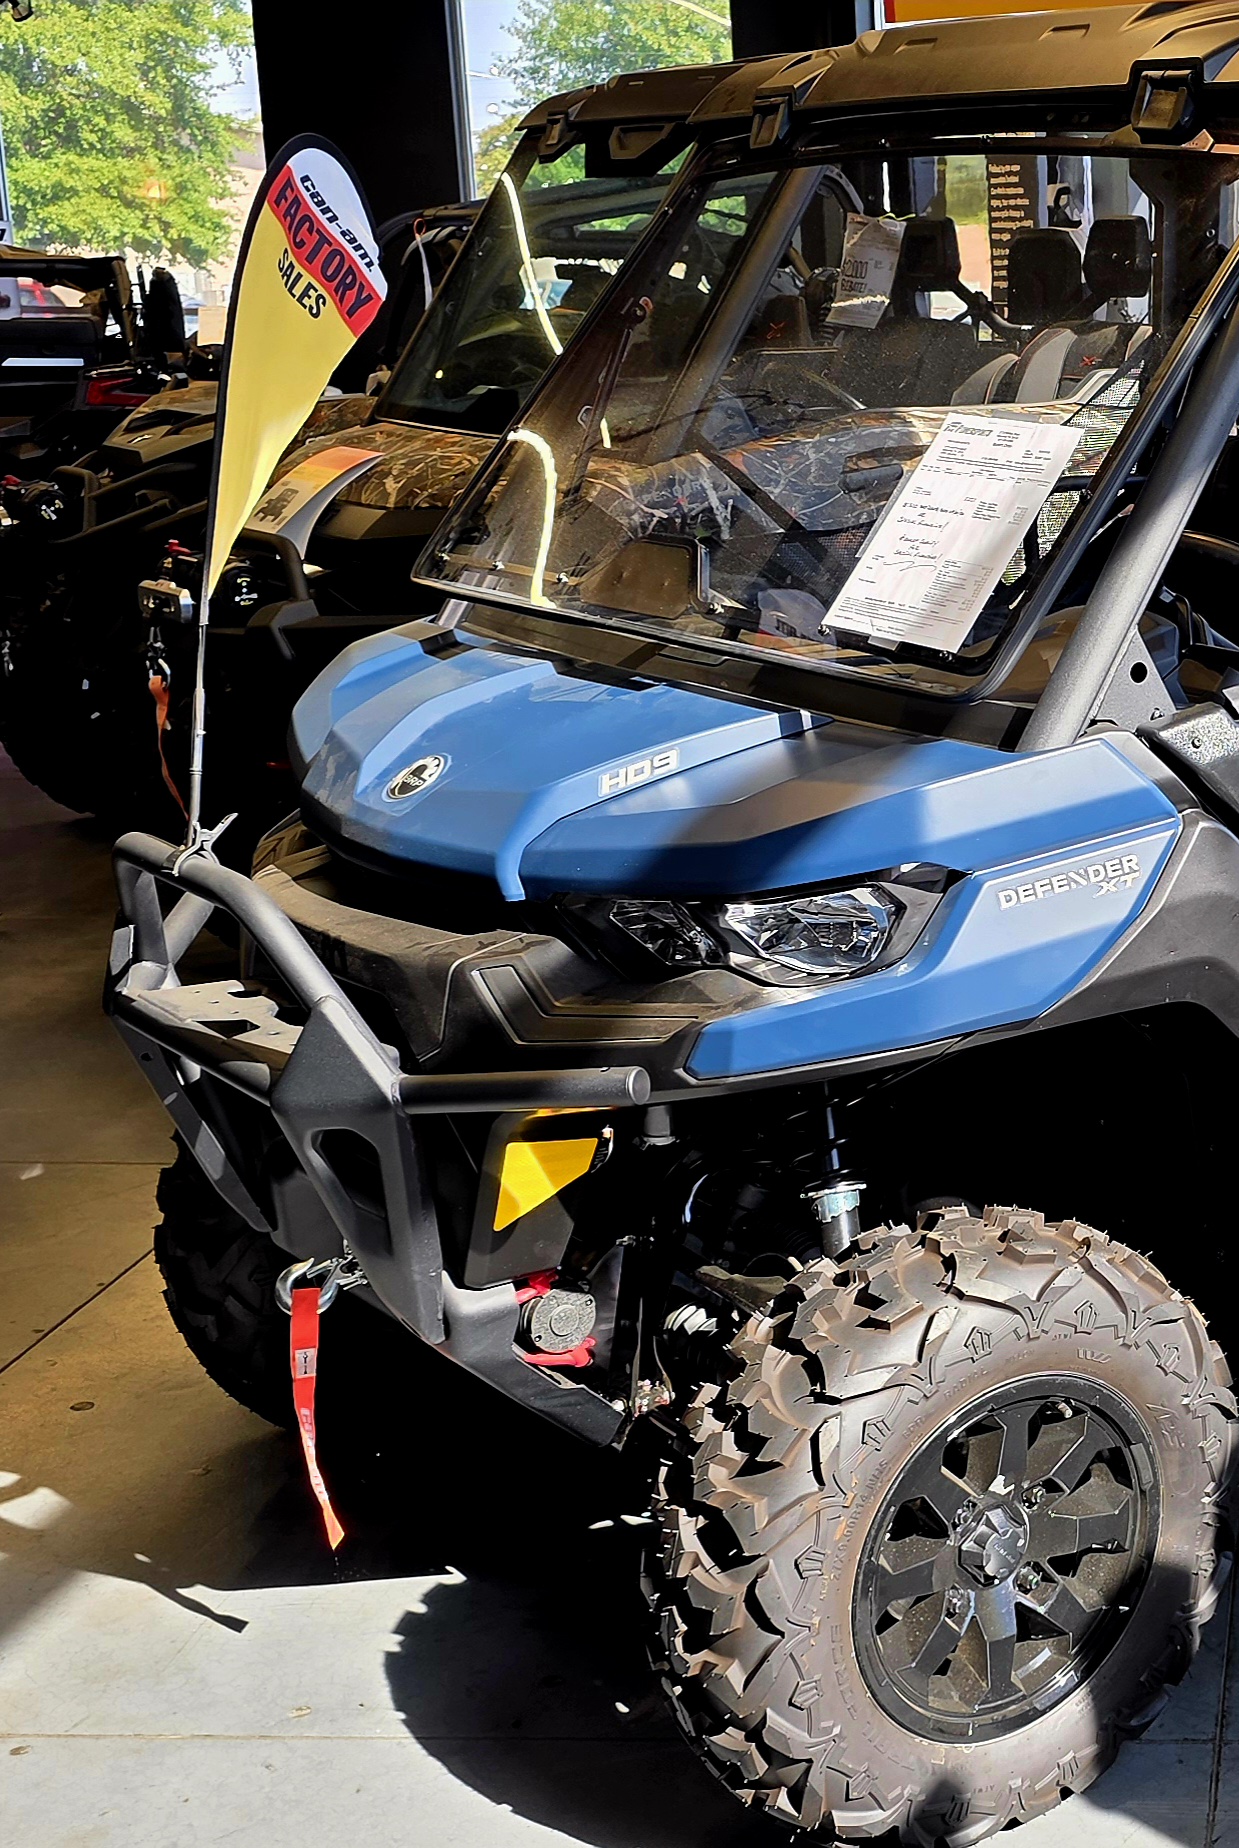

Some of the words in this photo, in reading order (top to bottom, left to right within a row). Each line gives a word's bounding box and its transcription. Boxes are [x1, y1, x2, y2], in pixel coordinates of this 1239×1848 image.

[273, 175, 375, 320] FACTORY
[300, 174, 375, 273] can-am
[277, 246, 328, 320] SALES
[601, 749, 678, 795] HD9
[998, 854, 1140, 911] DEFENDER
[1092, 871, 1142, 899] XT
